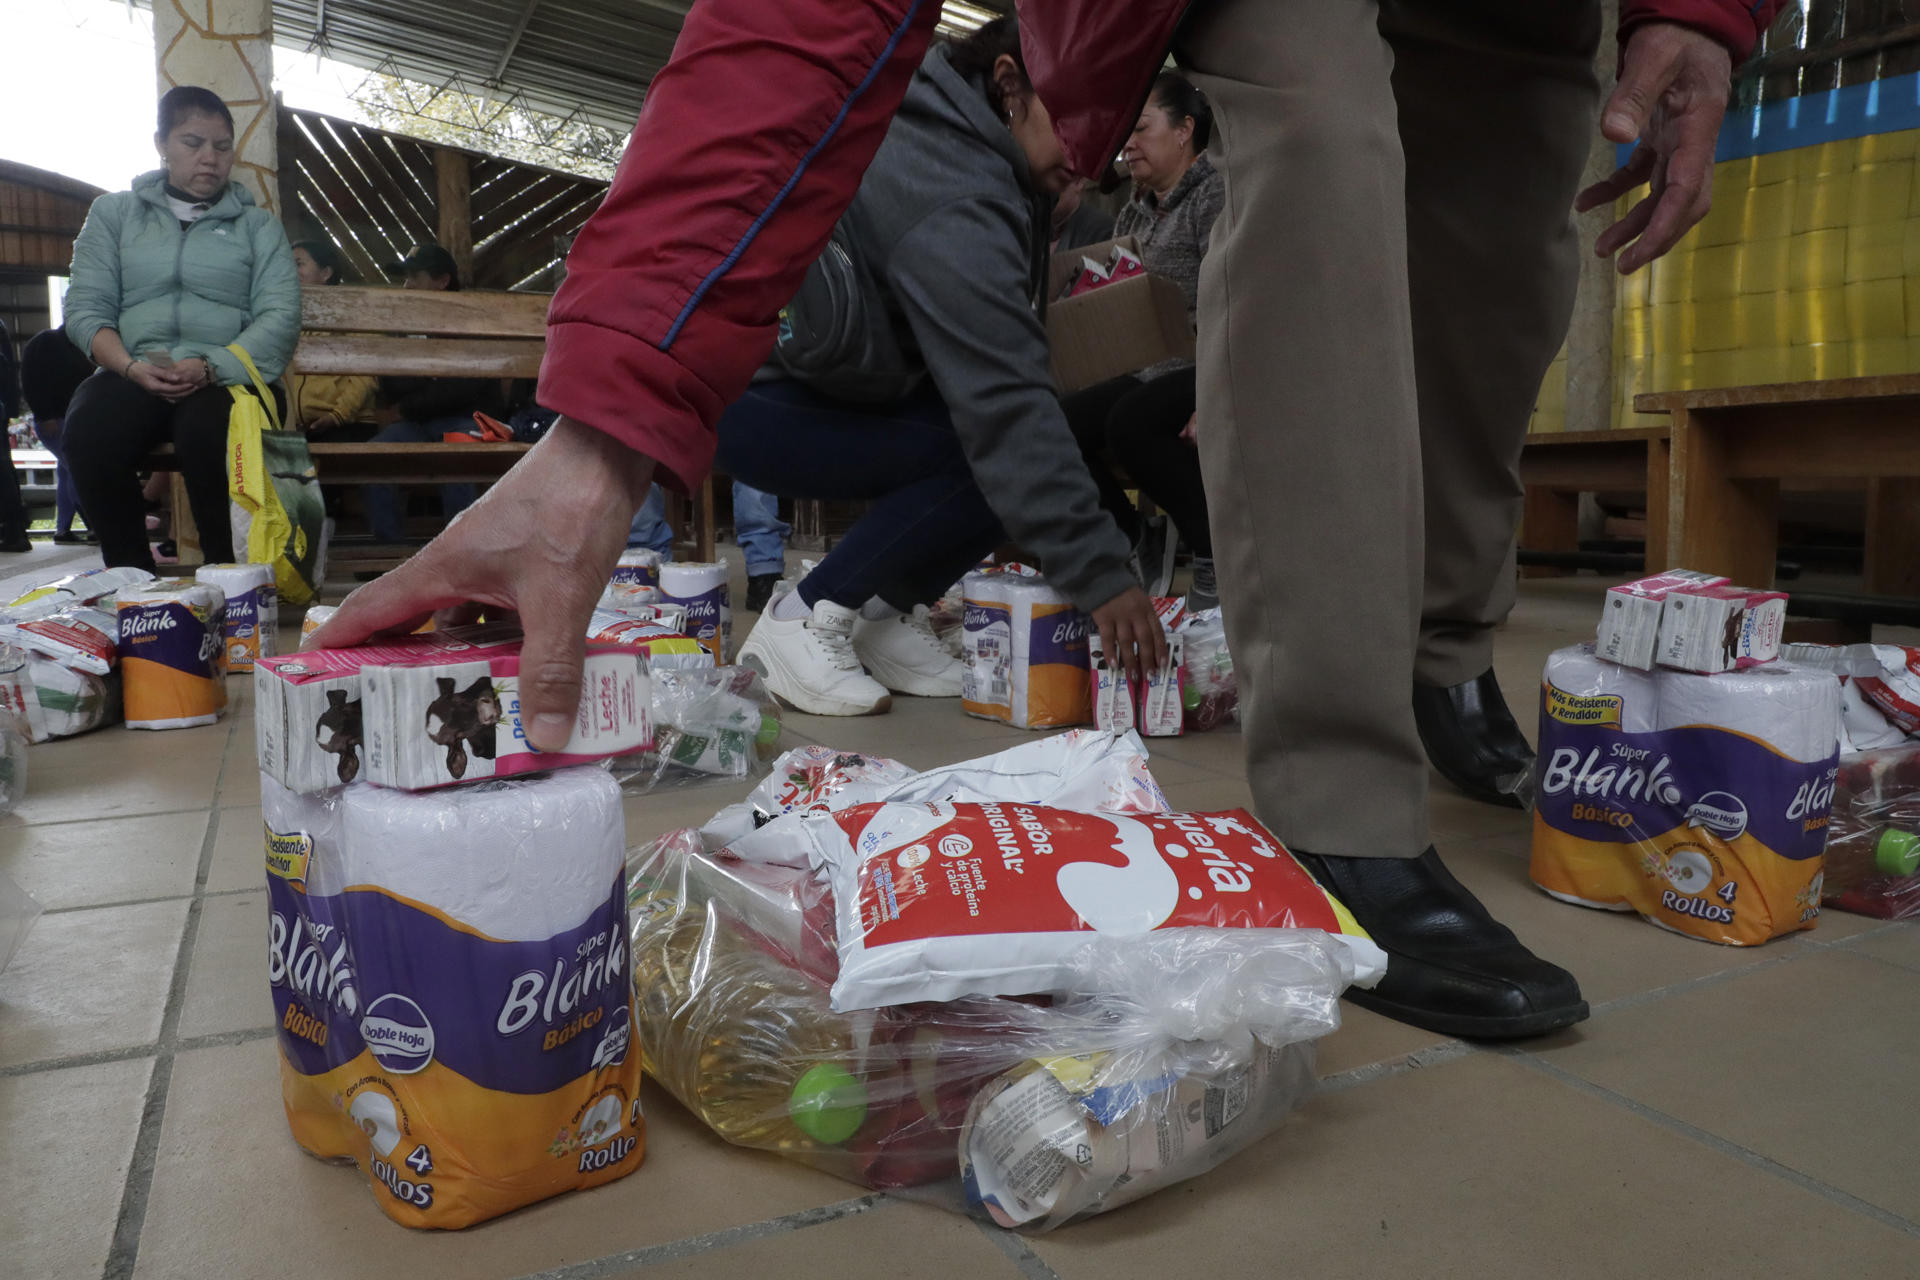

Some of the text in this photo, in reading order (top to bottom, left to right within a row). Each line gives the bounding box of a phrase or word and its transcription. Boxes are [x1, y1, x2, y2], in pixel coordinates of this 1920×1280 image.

[225, 602, 253, 618] ank
[601, 675, 614, 732] Leche
[1549, 688, 1618, 709] Más Resistente
[1551, 704, 1603, 720] y Rendidor
[1610, 742, 1650, 761] Súper
[1543, 748, 1681, 804] Blank
[1786, 776, 1836, 820] Bla
[1013, 805, 1054, 855] SABOR
[1571, 802, 1634, 828] Básico
[1694, 808, 1740, 826] Doble Hoja
[911, 868, 927, 896] Leche
[939, 861, 962, 896] y calcio
[956, 859, 980, 917] de proteína
[968, 857, 987, 891] Fuente
[1662, 890, 1735, 923] Rollos
[1718, 881, 1737, 902] 4
[497, 922, 626, 1034] Blank
[283, 1001, 329, 1047] Básico
[364, 1024, 425, 1049] Doble Hoja
[542, 1005, 604, 1051] Básico
[406, 1143, 432, 1172] 4
[578, 1135, 638, 1173] Rollo
